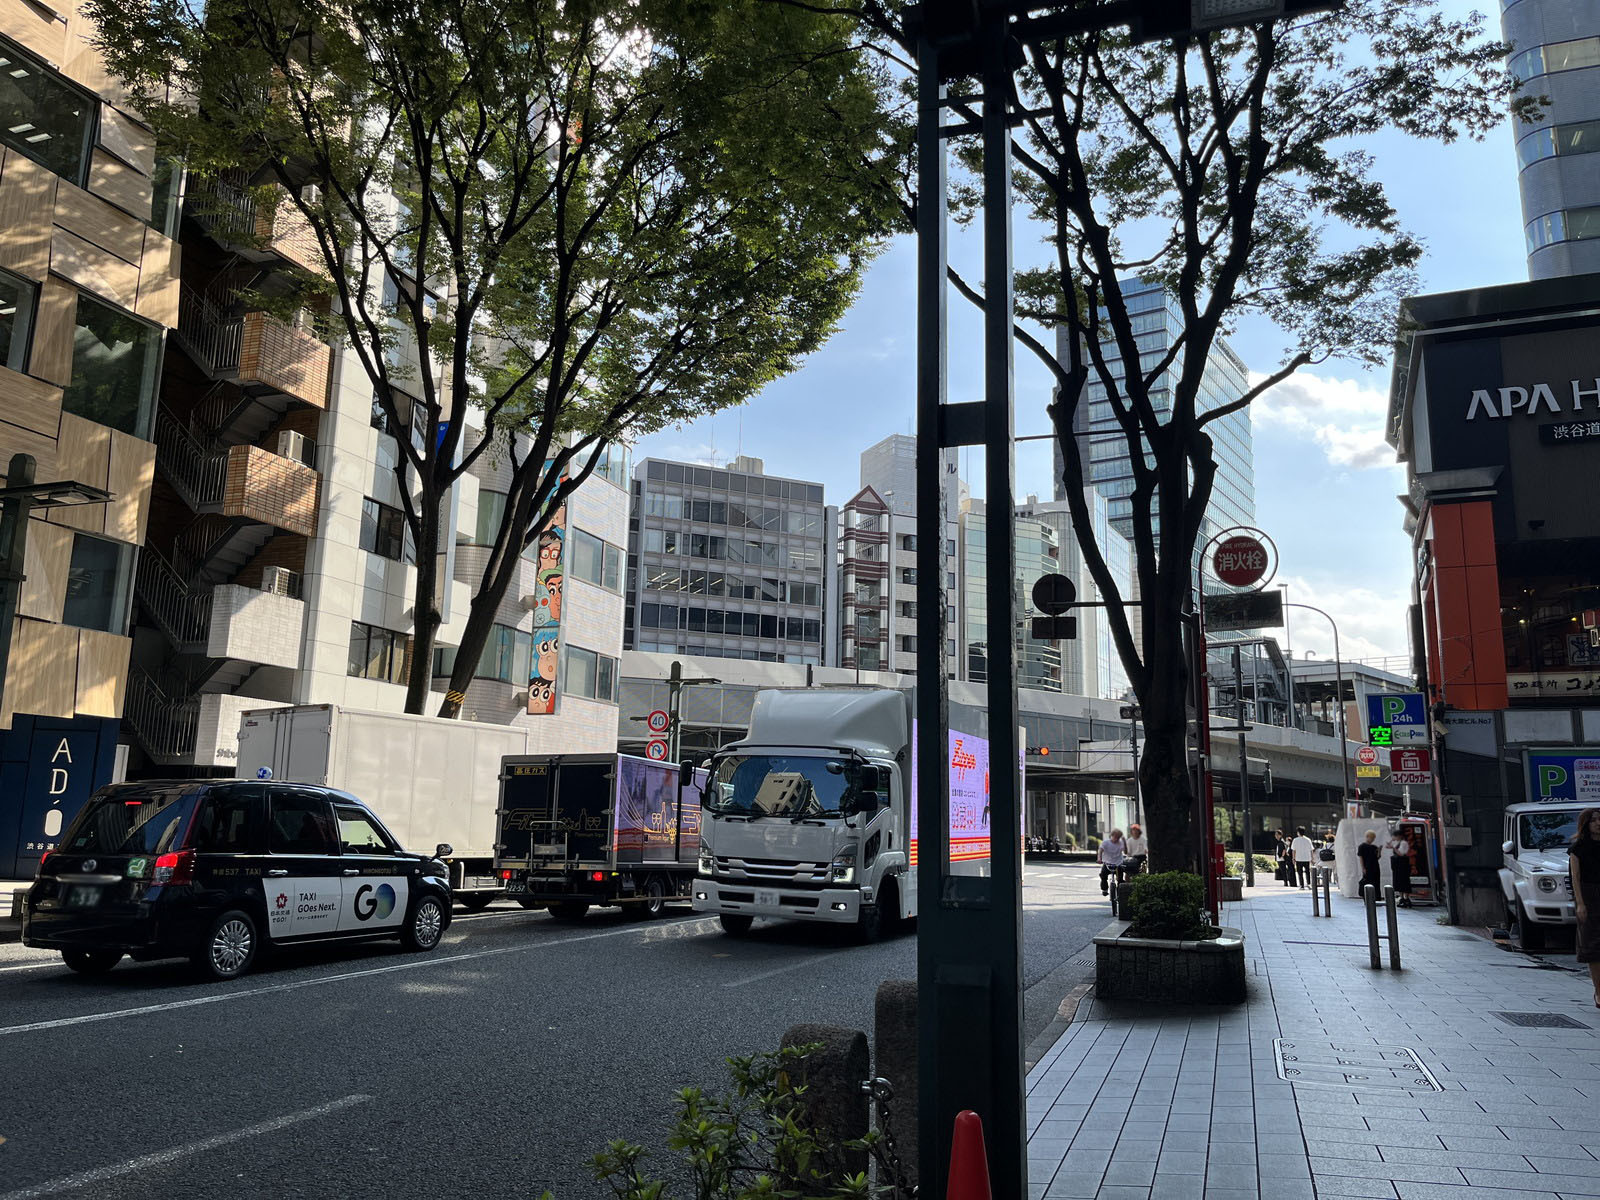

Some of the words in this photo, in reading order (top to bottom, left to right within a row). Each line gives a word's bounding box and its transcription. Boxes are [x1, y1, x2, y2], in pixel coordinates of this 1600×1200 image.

[1466, 386, 1561, 420] APA
[1553, 421, 1600, 438] 渋谷道
[1218, 550, 1263, 572] 消火栓
[1382, 696, 1406, 724] P
[1394, 714, 1412, 723] 24h
[652, 716, 664, 726] 40
[1369, 725, 1393, 745] 空
[1393, 773, 1431, 783] コインロッカー
[1538, 764, 1568, 797] P
[299, 892, 317, 902] TAXI
[298, 904, 318, 914] GOes
